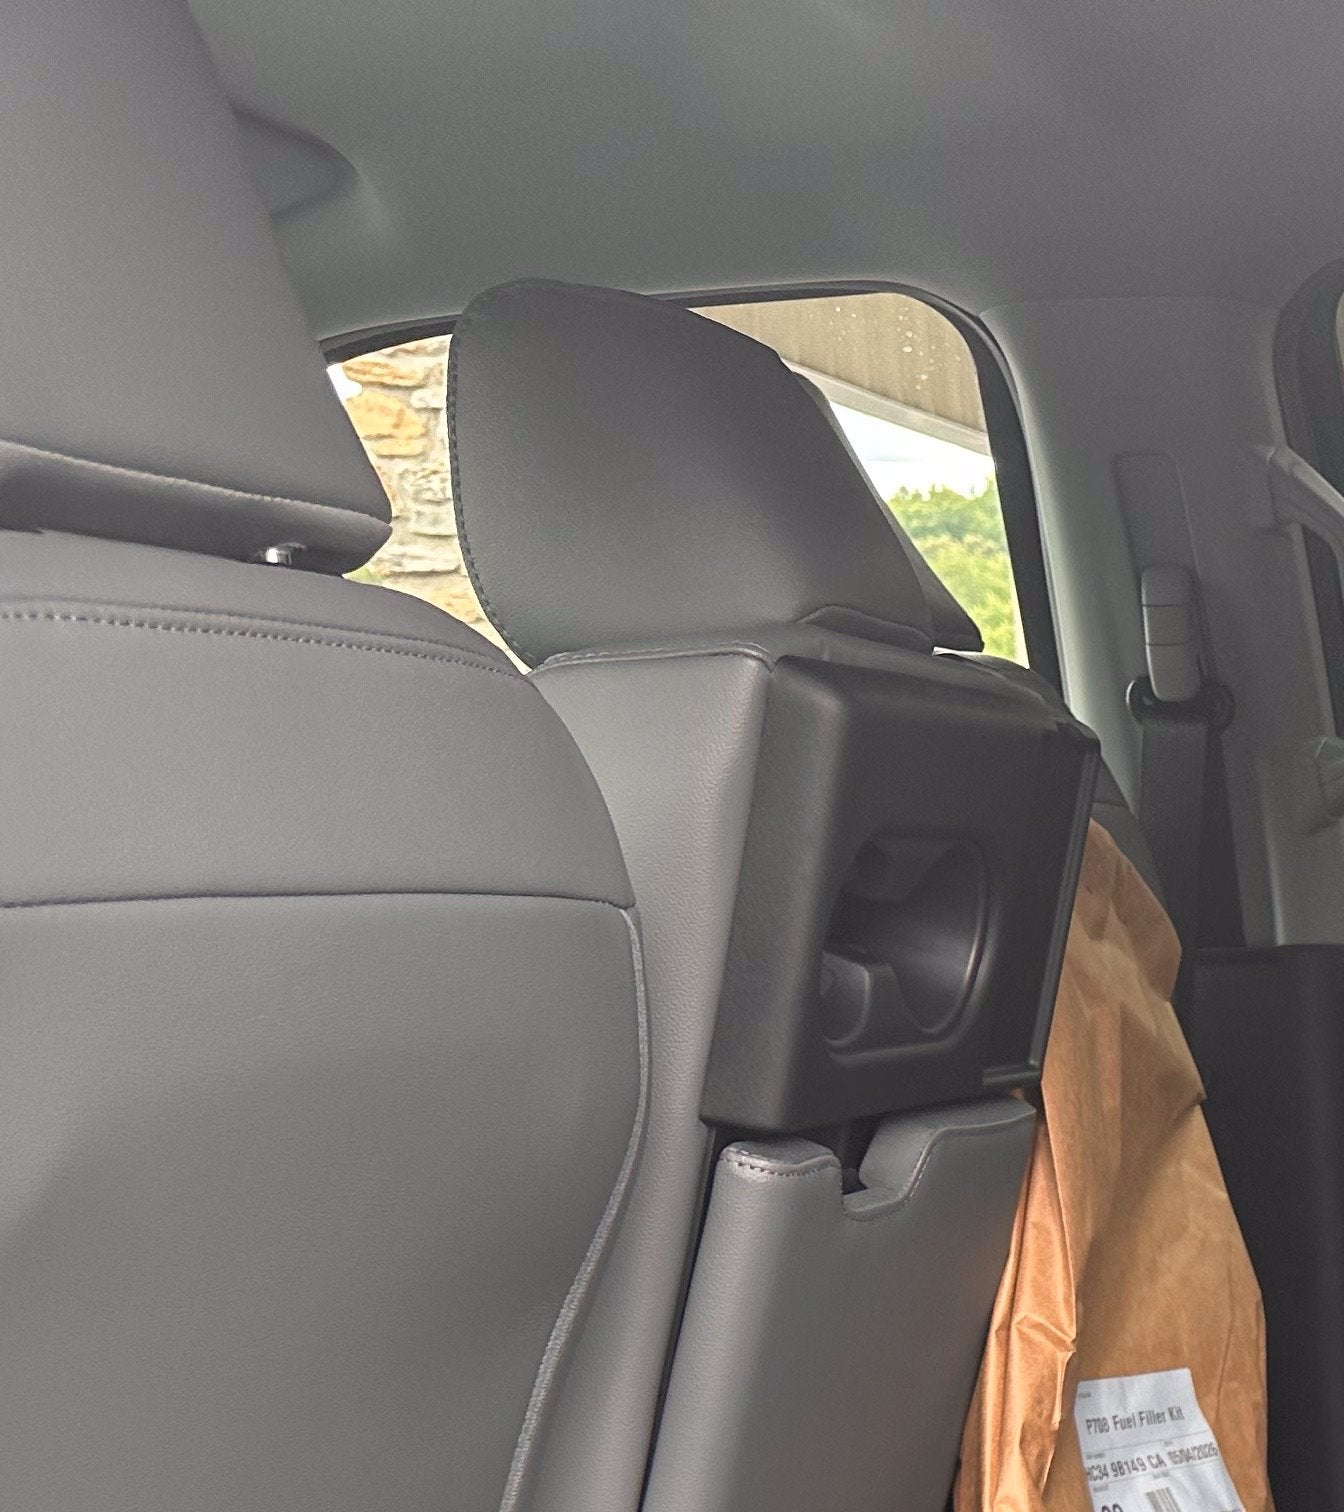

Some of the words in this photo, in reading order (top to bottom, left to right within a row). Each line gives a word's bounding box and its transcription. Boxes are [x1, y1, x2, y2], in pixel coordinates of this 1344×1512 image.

[1112, 1412, 1136, 1431] Fuel
[1138, 1409, 1167, 1427] Filler
[1168, 1405, 1185, 1421] Kit
[1110, 1457, 1147, 1478] 9B149
[1147, 1453, 1168, 1469] CA
